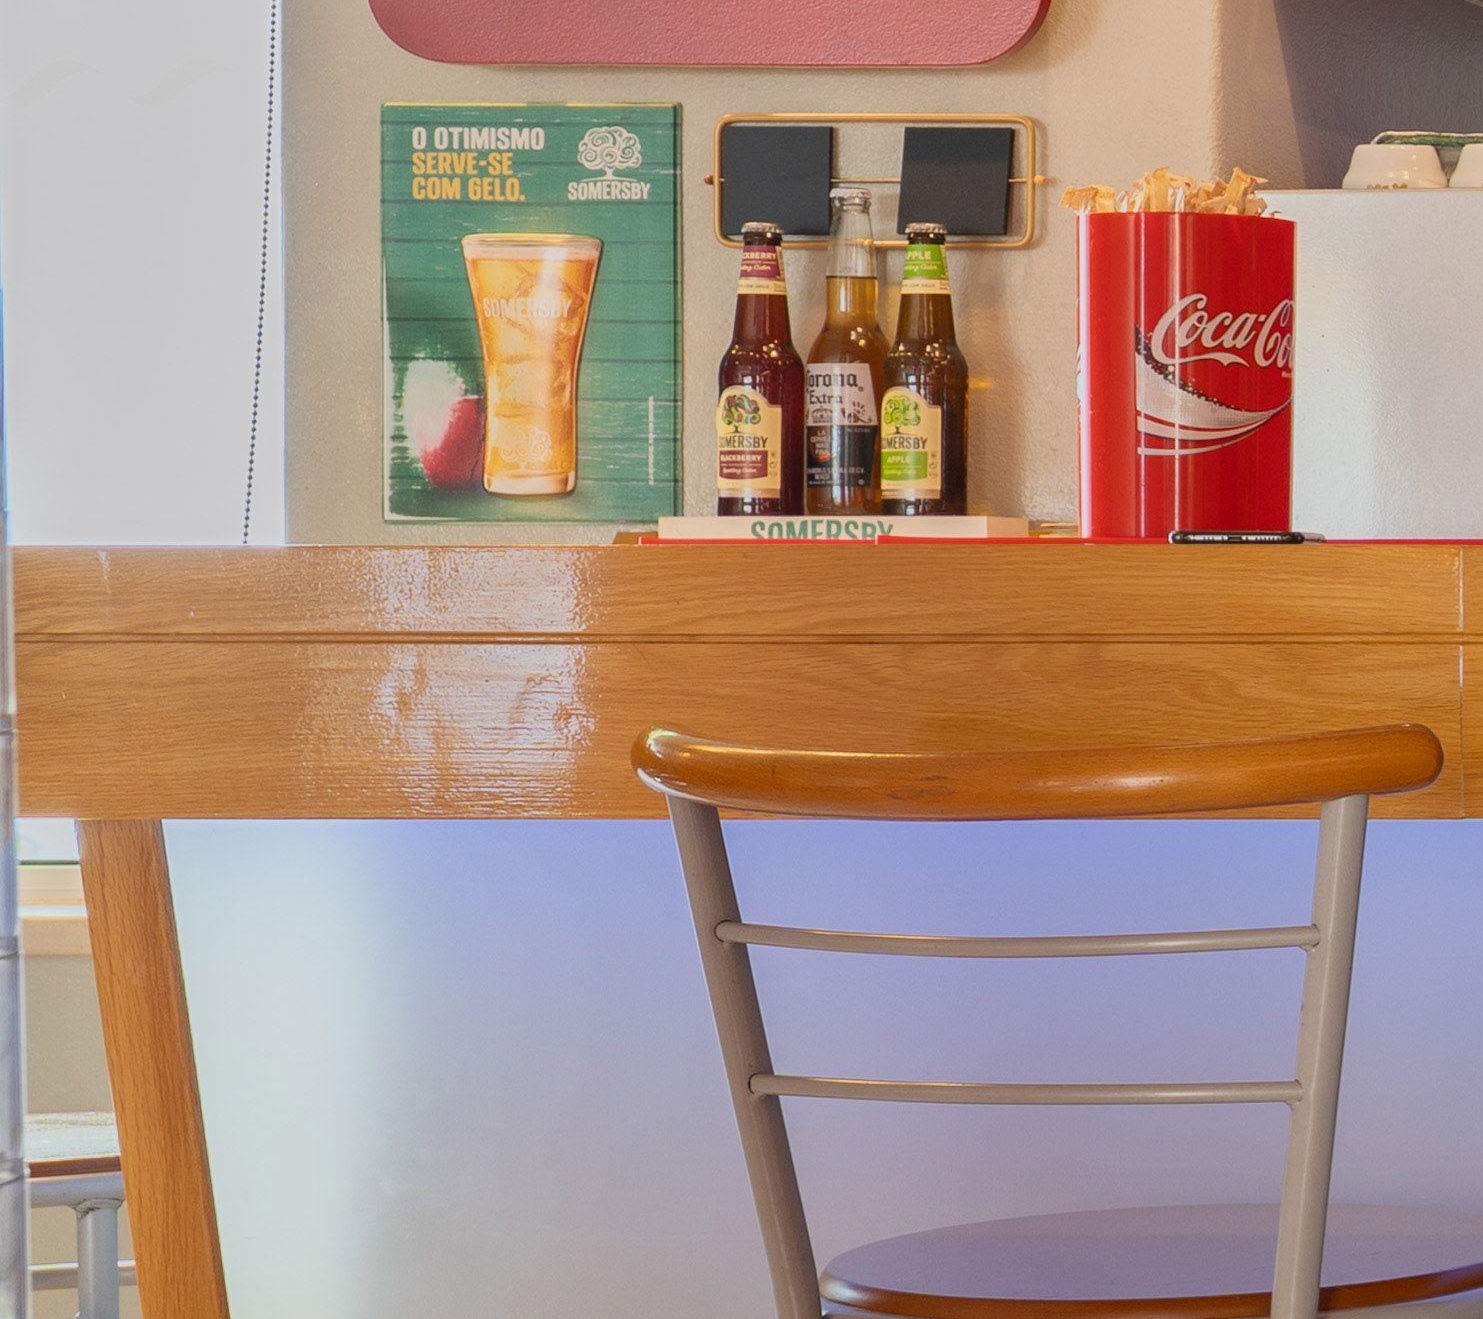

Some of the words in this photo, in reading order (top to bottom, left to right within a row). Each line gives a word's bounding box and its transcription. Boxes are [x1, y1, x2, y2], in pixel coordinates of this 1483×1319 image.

[412, 127, 426, 150] O
[434, 127, 545, 150] OTIMISMO
[411, 152, 513, 175] SERVE-SE
[411, 178, 461, 200] COM
[468, 178, 526, 202] GELO.
[568, 182, 650, 200] SOMERSBY
[483, 298, 572, 318] SOMERSBY
[1151, 293, 1294, 368] Coca-Co
[750, 519, 894, 540] SOMERSBY
